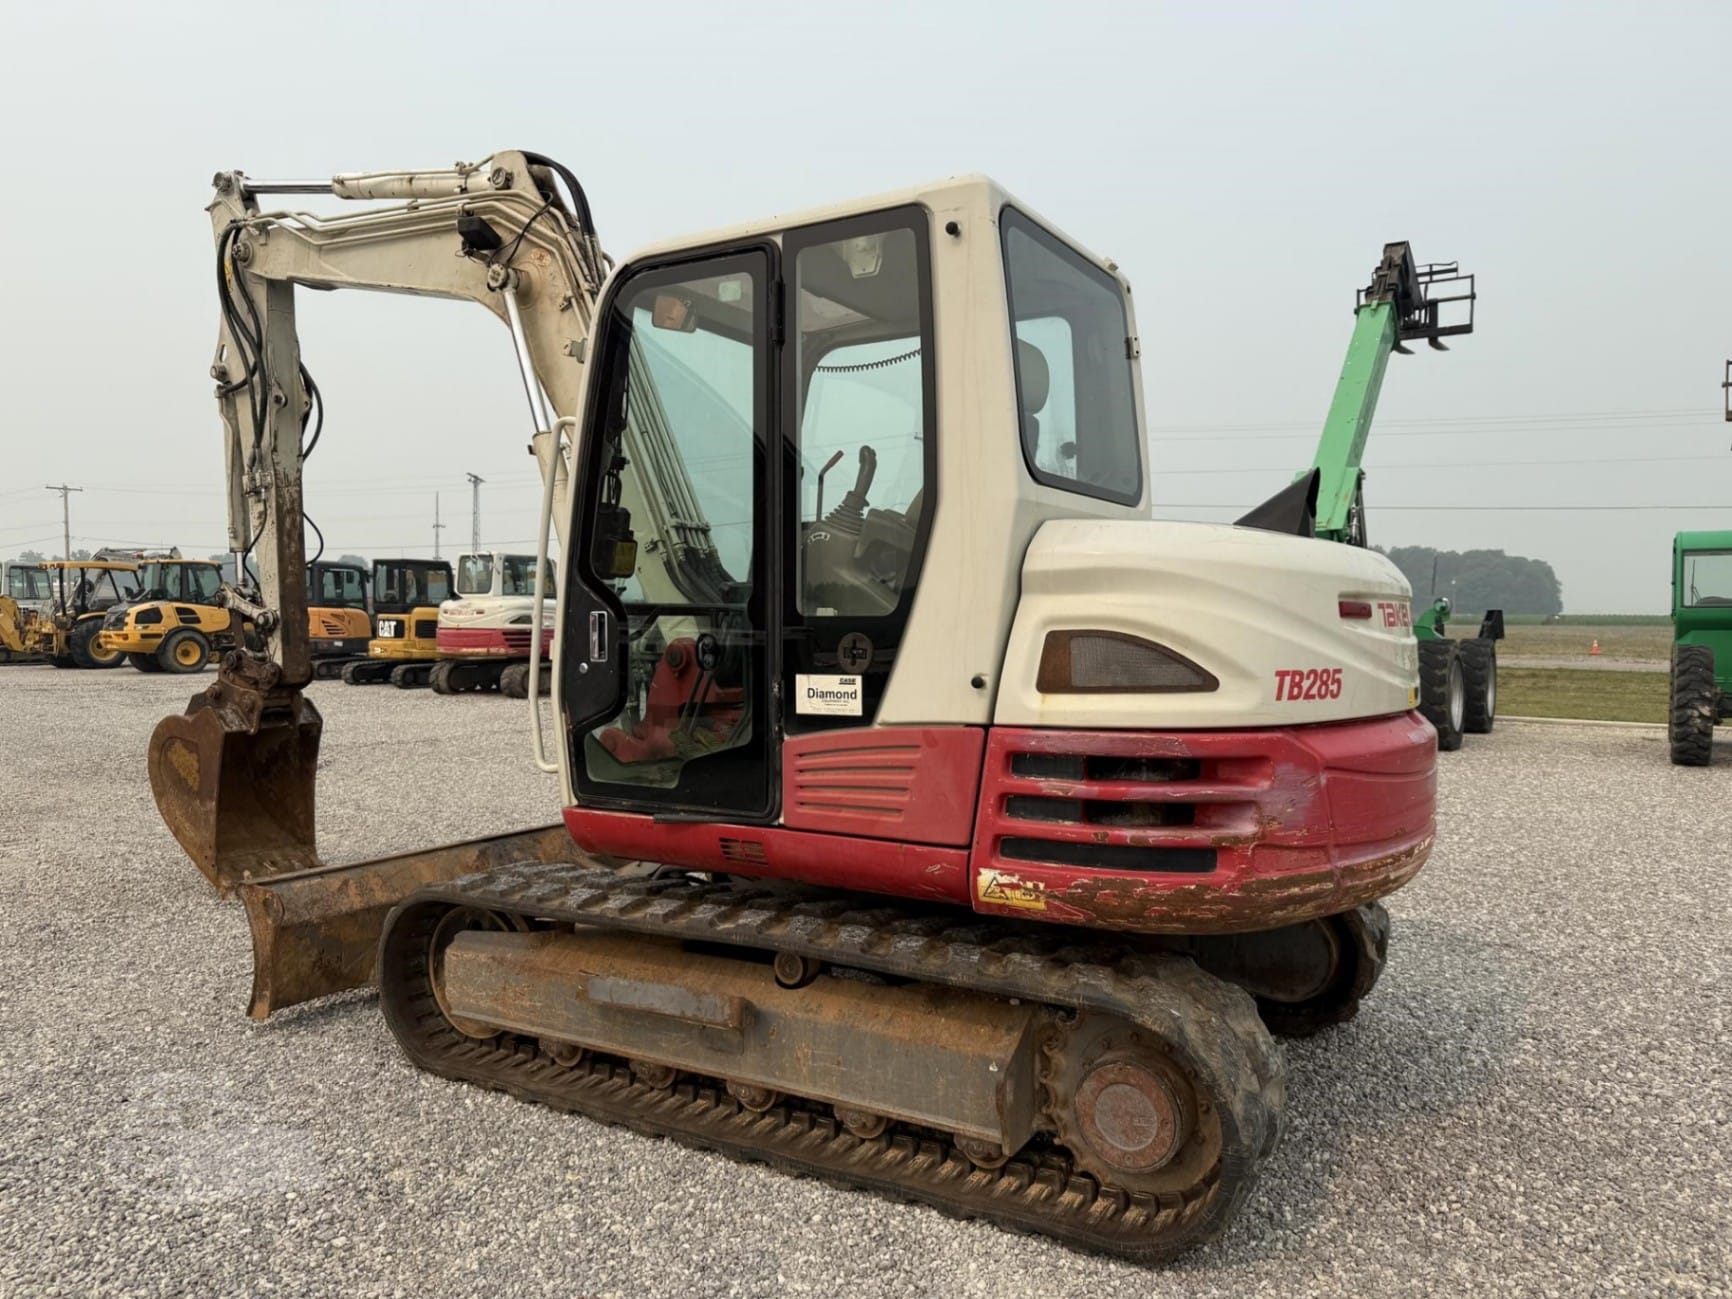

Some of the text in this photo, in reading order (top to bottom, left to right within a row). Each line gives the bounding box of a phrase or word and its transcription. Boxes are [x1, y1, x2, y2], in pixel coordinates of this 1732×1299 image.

[378, 620, 397, 638] CAT
[807, 687, 857, 700] Diamond
[1274, 668, 1343, 702] TB285
